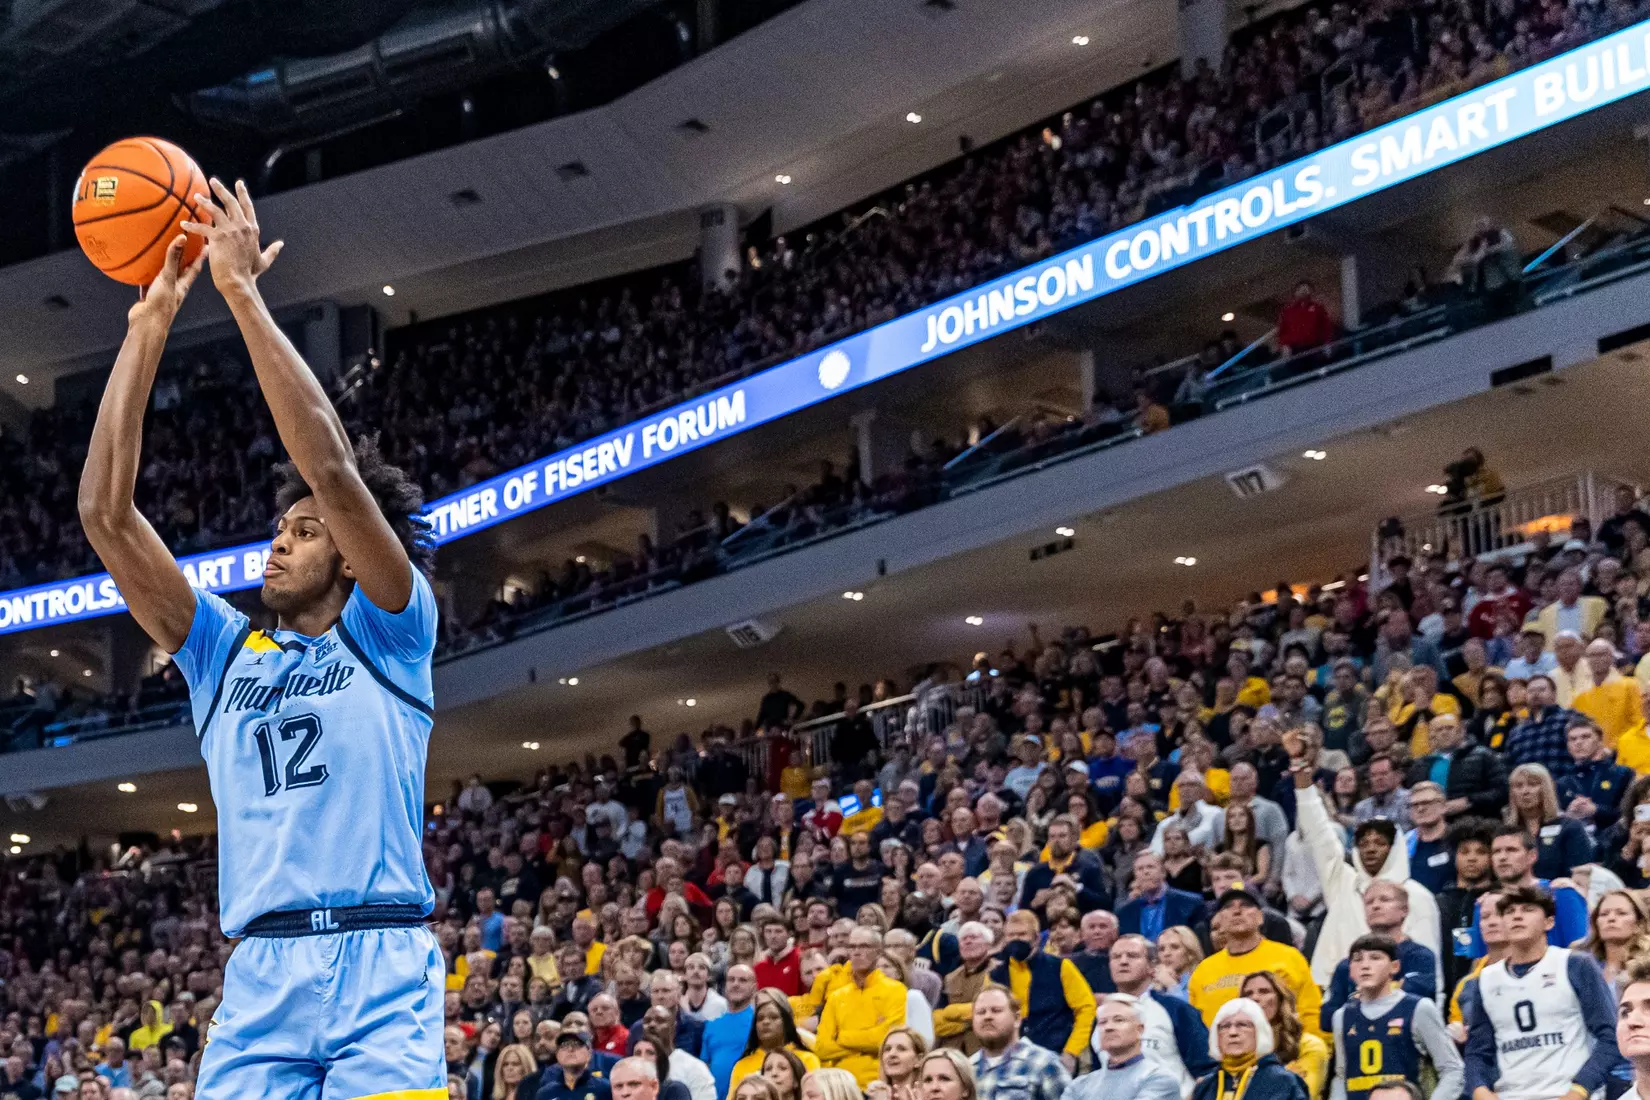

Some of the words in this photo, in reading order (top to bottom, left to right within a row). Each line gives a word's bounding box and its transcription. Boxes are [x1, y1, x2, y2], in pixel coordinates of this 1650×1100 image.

[921, 253, 1094, 353] JOHNSON
[1105, 165, 1336, 280] CONTROLS.
[1351, 87, 1518, 186] SMART
[422, 488, 498, 538] TNER
[504, 466, 538, 509] OF
[544, 434, 634, 496] FISERV
[642, 390, 746, 458] FORUM
[0, 582, 126, 628] ONTROLS.
[183, 556, 236, 589] ART
[315, 640, 331, 655] BIG
[315, 642, 339, 661] EAST
[253, 712, 330, 797] 12
[1515, 1000, 1537, 1033] 0
[1359, 1039, 1383, 1074] 0
